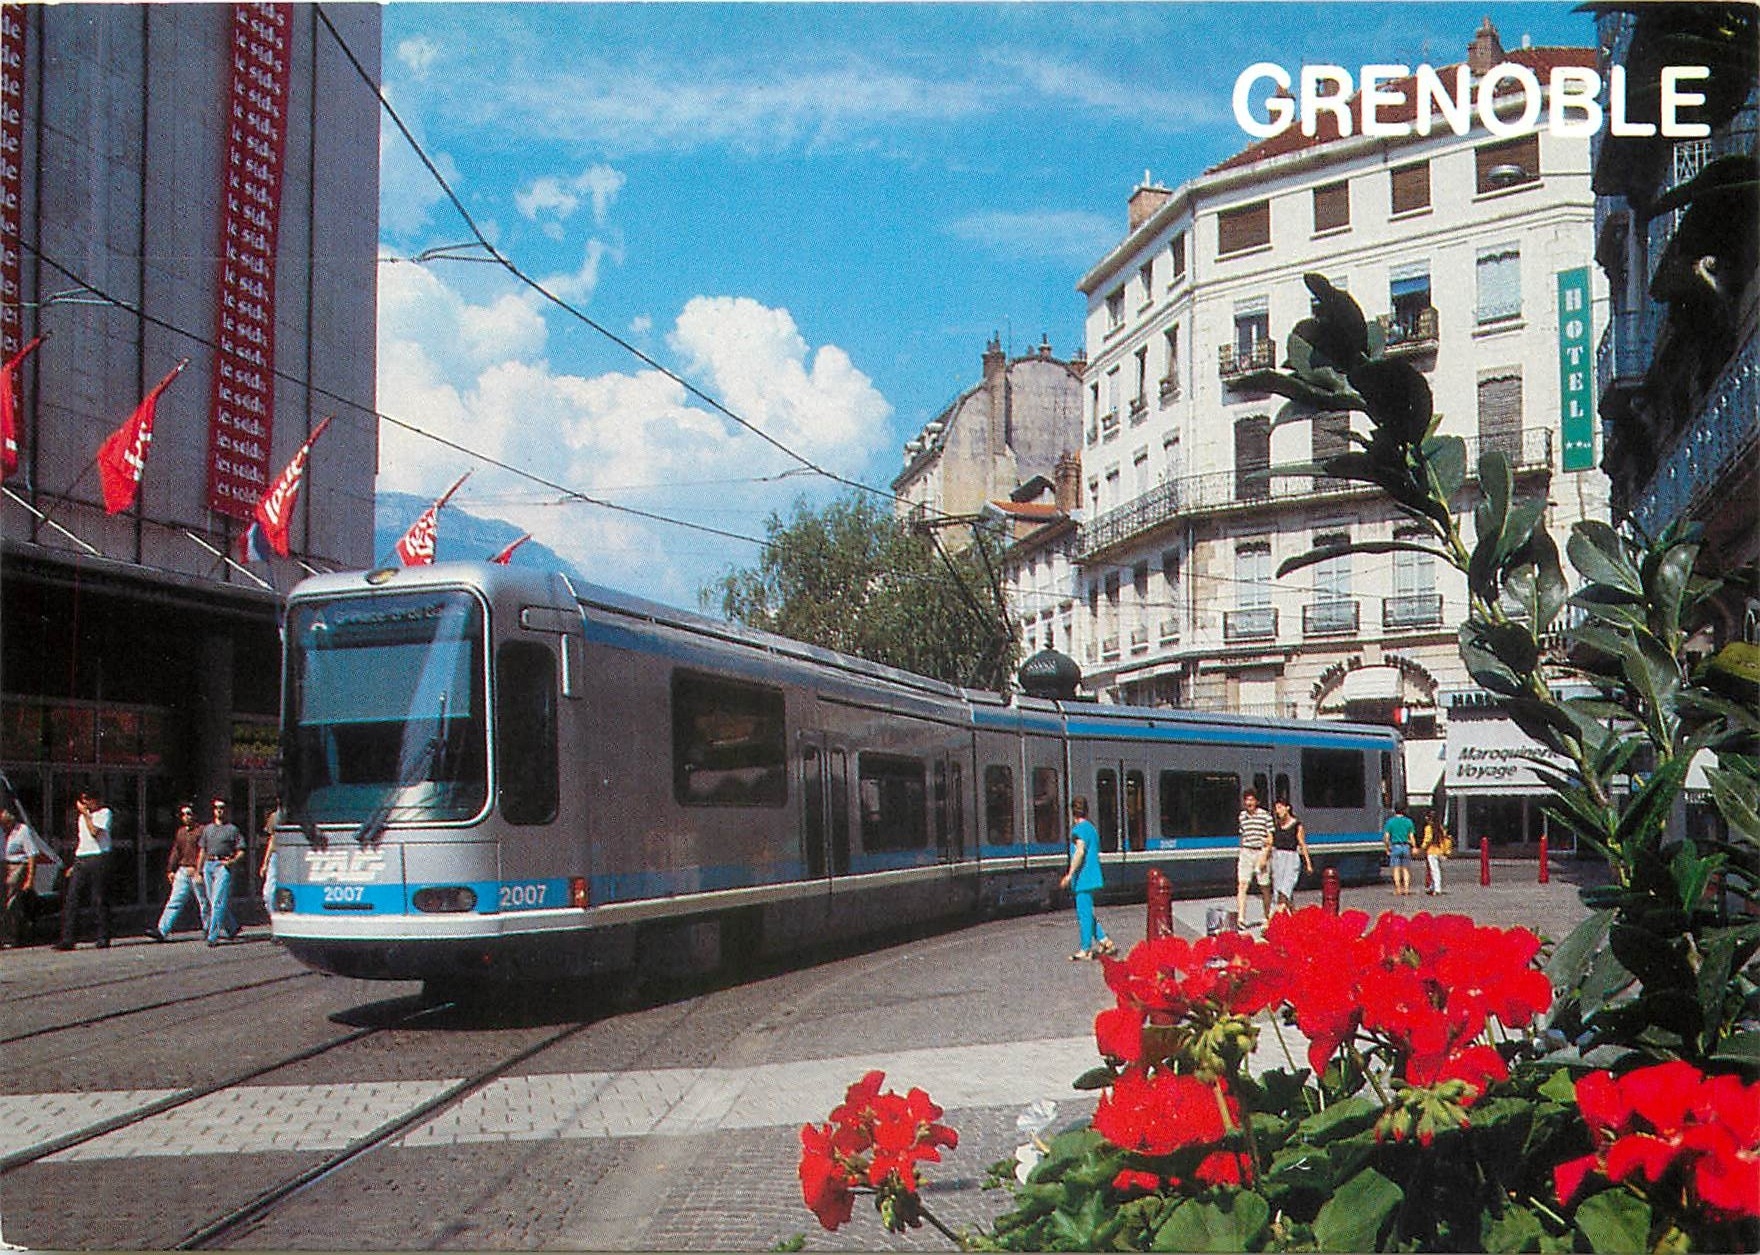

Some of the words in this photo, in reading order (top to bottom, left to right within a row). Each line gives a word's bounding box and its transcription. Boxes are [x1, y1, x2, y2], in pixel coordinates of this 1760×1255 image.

[1565, 287, 1584, 418] HOTEL
[1457, 764, 1518, 779] Voyage
[323, 886, 365, 901] 2007
[499, 884, 547, 907] 2007
